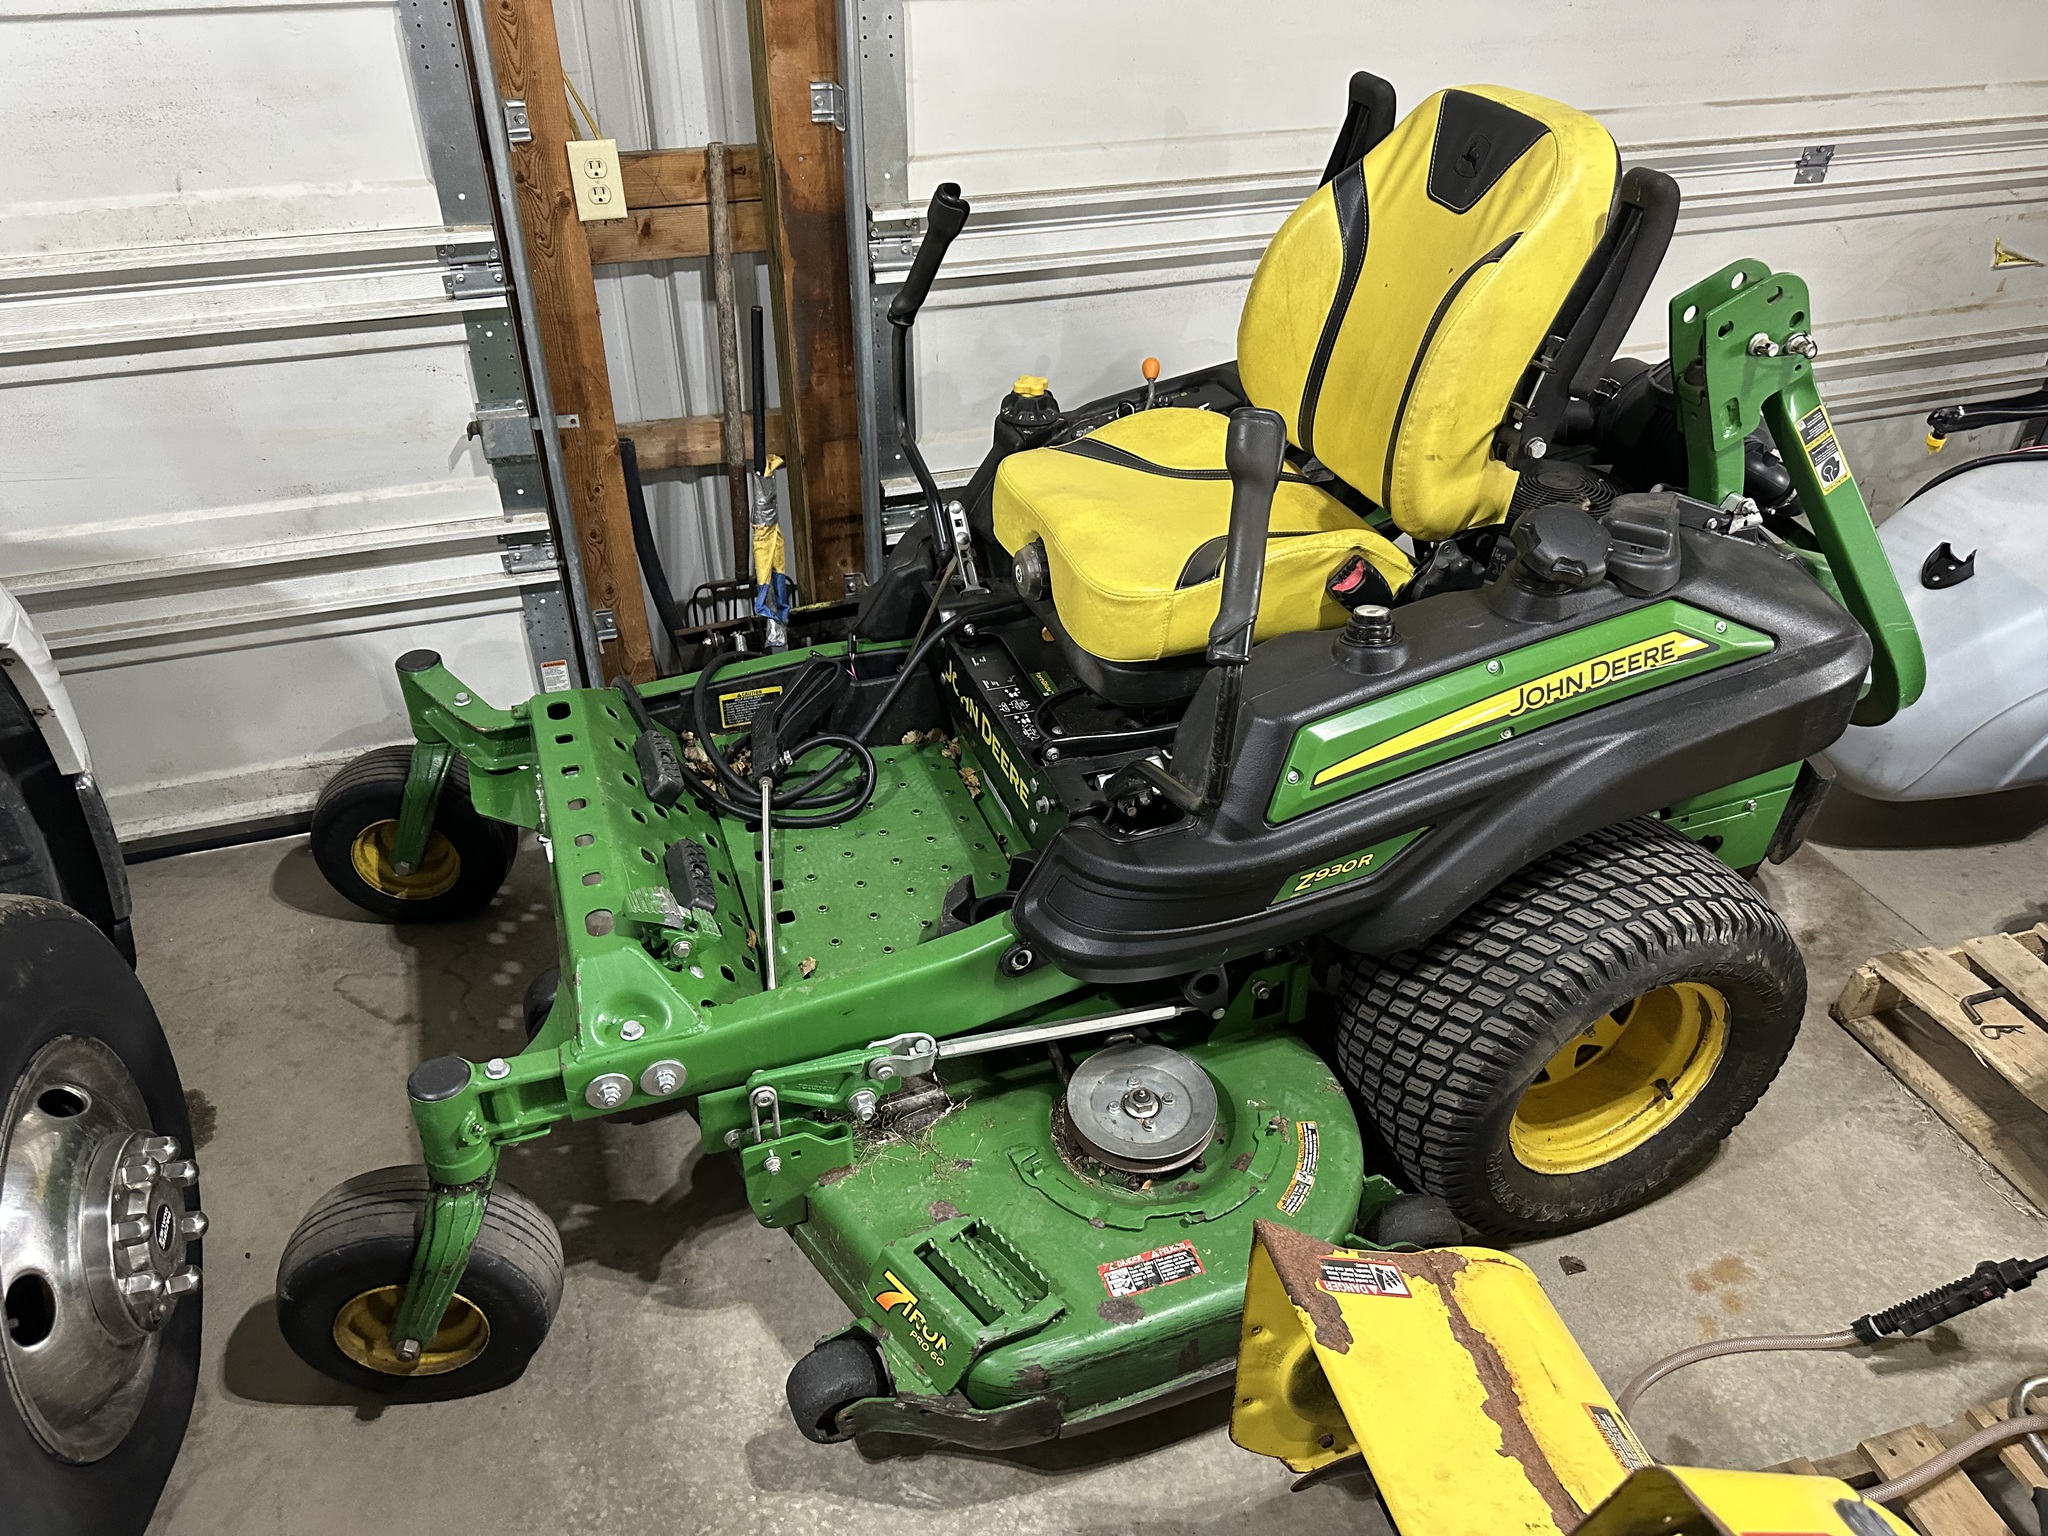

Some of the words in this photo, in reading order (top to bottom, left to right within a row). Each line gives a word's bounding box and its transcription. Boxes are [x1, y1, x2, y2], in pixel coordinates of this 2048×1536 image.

[1510, 671, 1582, 713] JOHN
[1590, 641, 1675, 686] DEERE
[982, 712, 1029, 810] DEERE
[1294, 853, 1374, 891] Z930R
[1324, 1281, 1370, 1293] DANGER
[910, 1330, 930, 1351] PRO
[930, 1351, 944, 1366] 60
[1591, 1416, 1620, 1459] WARNING
